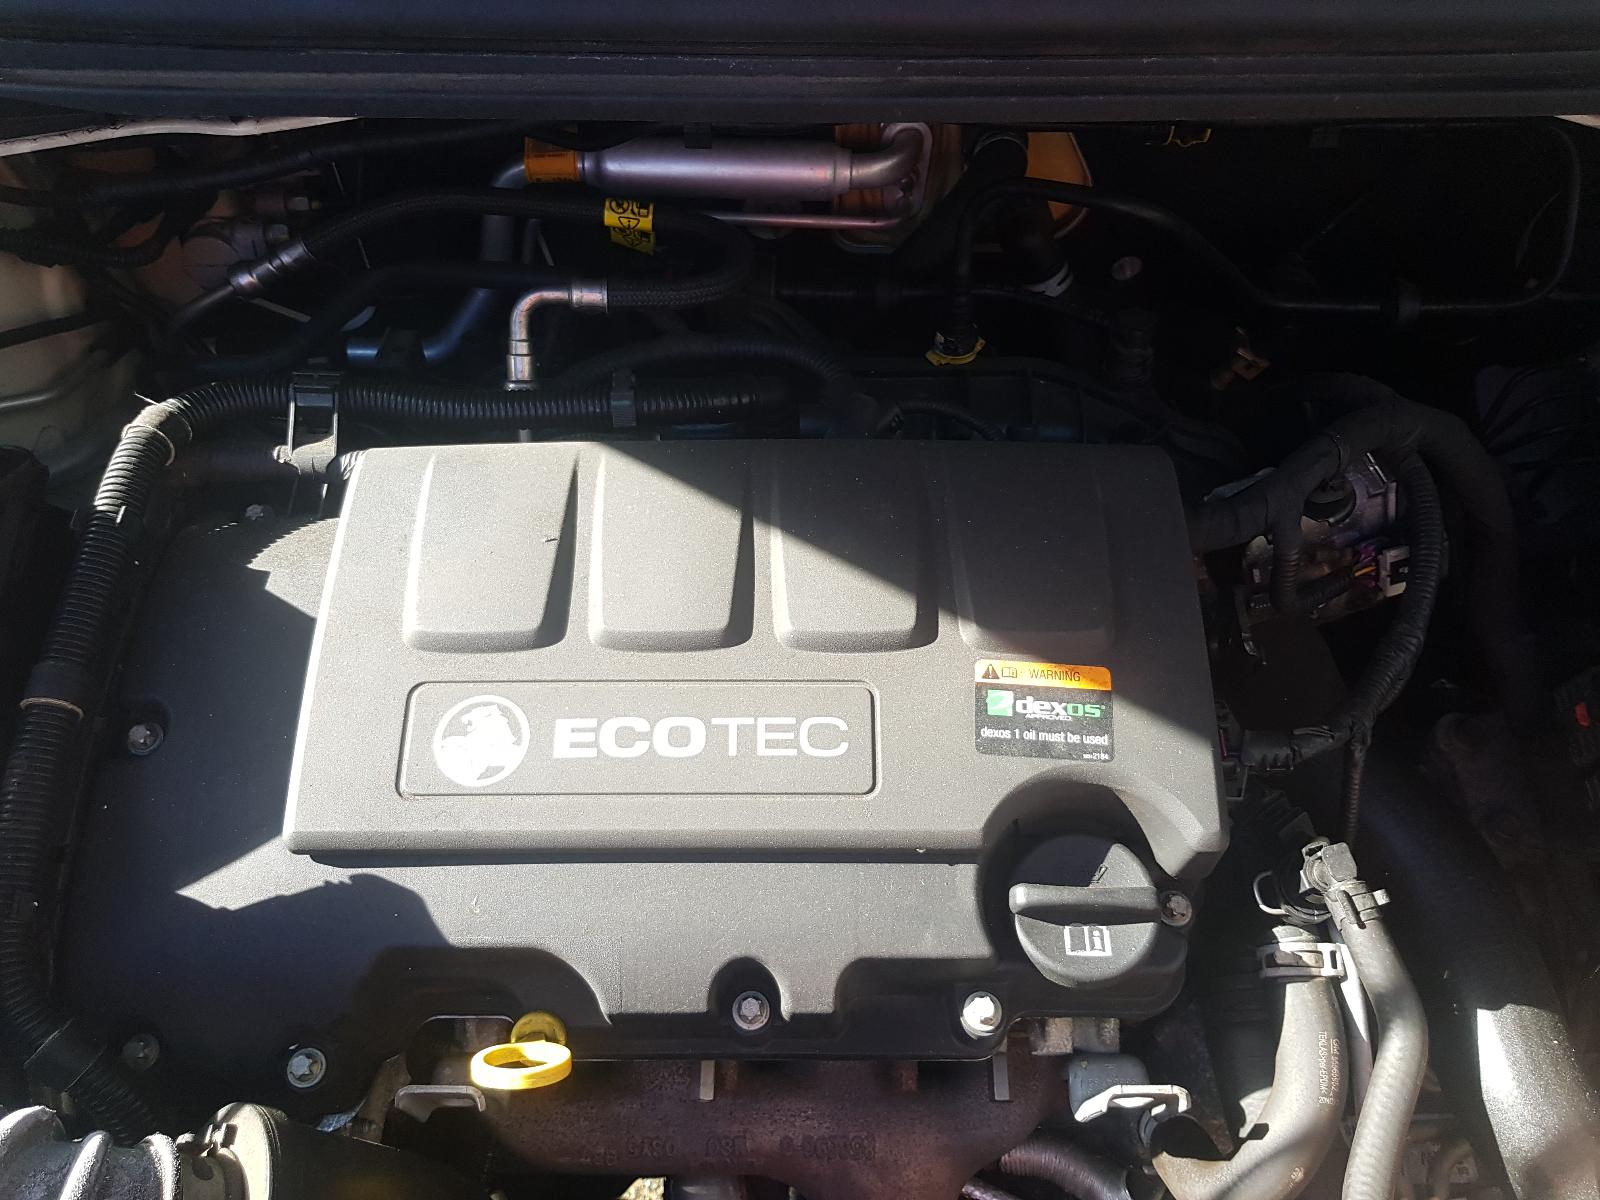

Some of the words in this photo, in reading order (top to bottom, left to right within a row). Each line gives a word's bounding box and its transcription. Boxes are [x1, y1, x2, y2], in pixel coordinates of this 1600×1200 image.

[1029, 668, 1081, 682] WARNING
[1016, 695, 1102, 718] dexos
[553, 716, 849, 758] ECOTEC
[981, 726, 1012, 739] dexos
[1014, 728, 1020, 739] 1
[1023, 729, 1036, 740] oil
[1039, 731, 1066, 743] must
[1067, 732, 1081, 744] be
[1083, 734, 1109, 745] used
